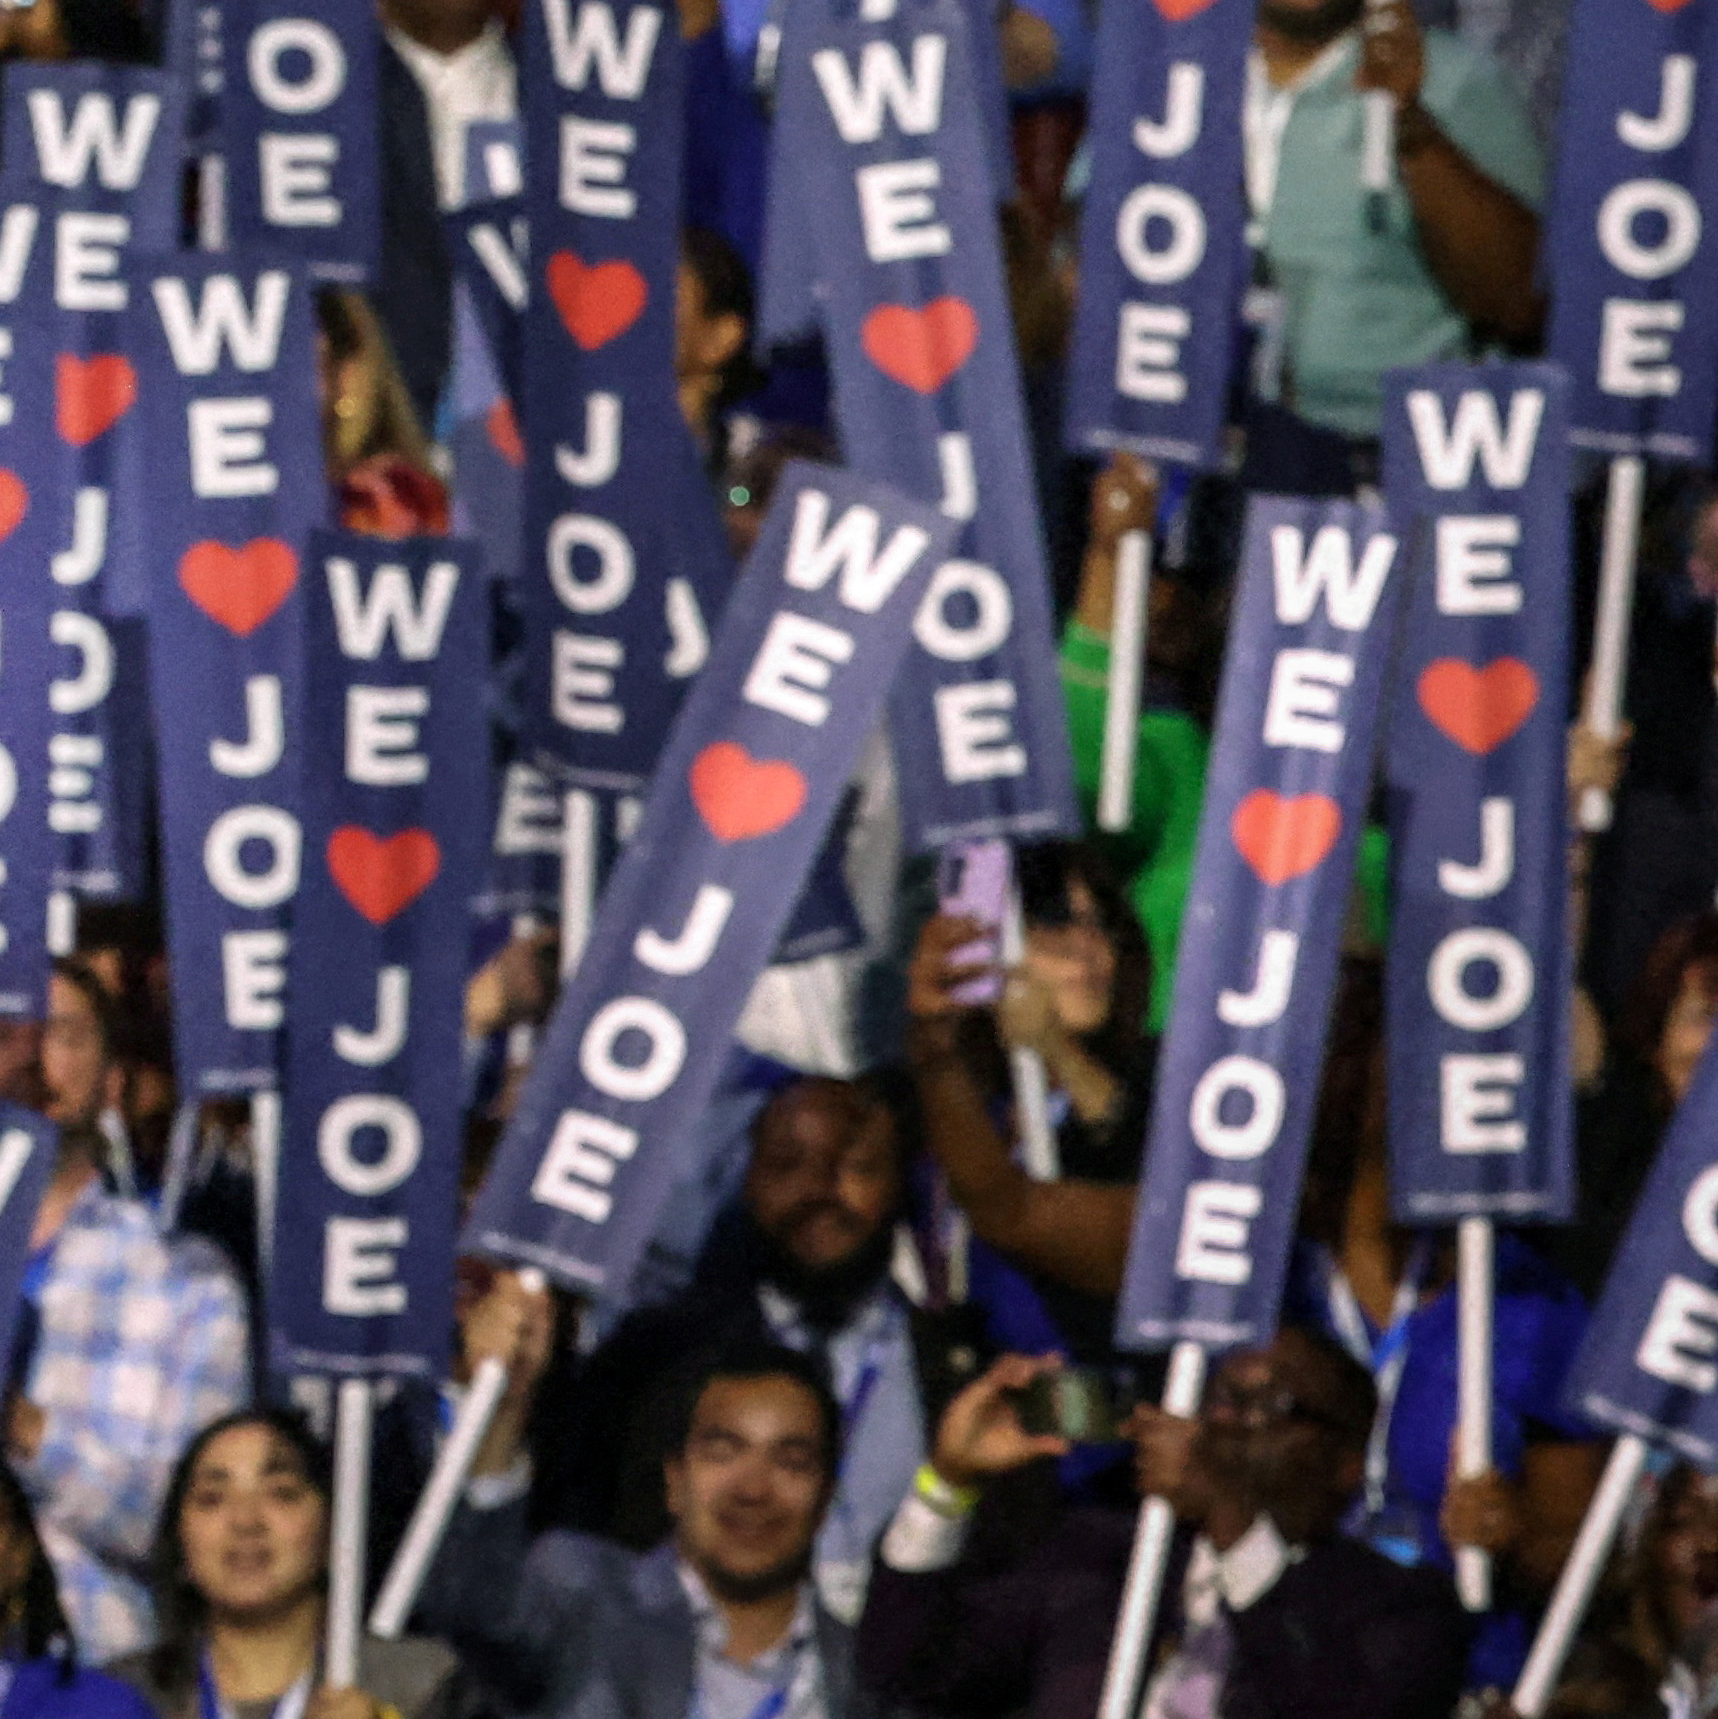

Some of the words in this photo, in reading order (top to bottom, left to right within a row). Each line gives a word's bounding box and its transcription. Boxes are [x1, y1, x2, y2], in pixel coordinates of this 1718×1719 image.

[28, 89, 160, 310] WE
[810, 32, 953, 263] WE
[1117, 62, 1205, 401] JOE
[1599, 57, 1699, 394] JOE
[152, 271, 288, 498] WE
[1407, 389, 1544, 616] WE
[328, 559, 457, 784] WE
[550, 394, 633, 731] JOE
[743, 487, 929, 727] WE
[1261, 522, 1398, 752] WE
[203, 675, 301, 1028] JOE
[1429, 798, 1533, 1153] JOE
[320, 968, 420, 1314] JOE
[532, 879, 737, 1223] JOE
[1175, 927, 1305, 1285] JOE
